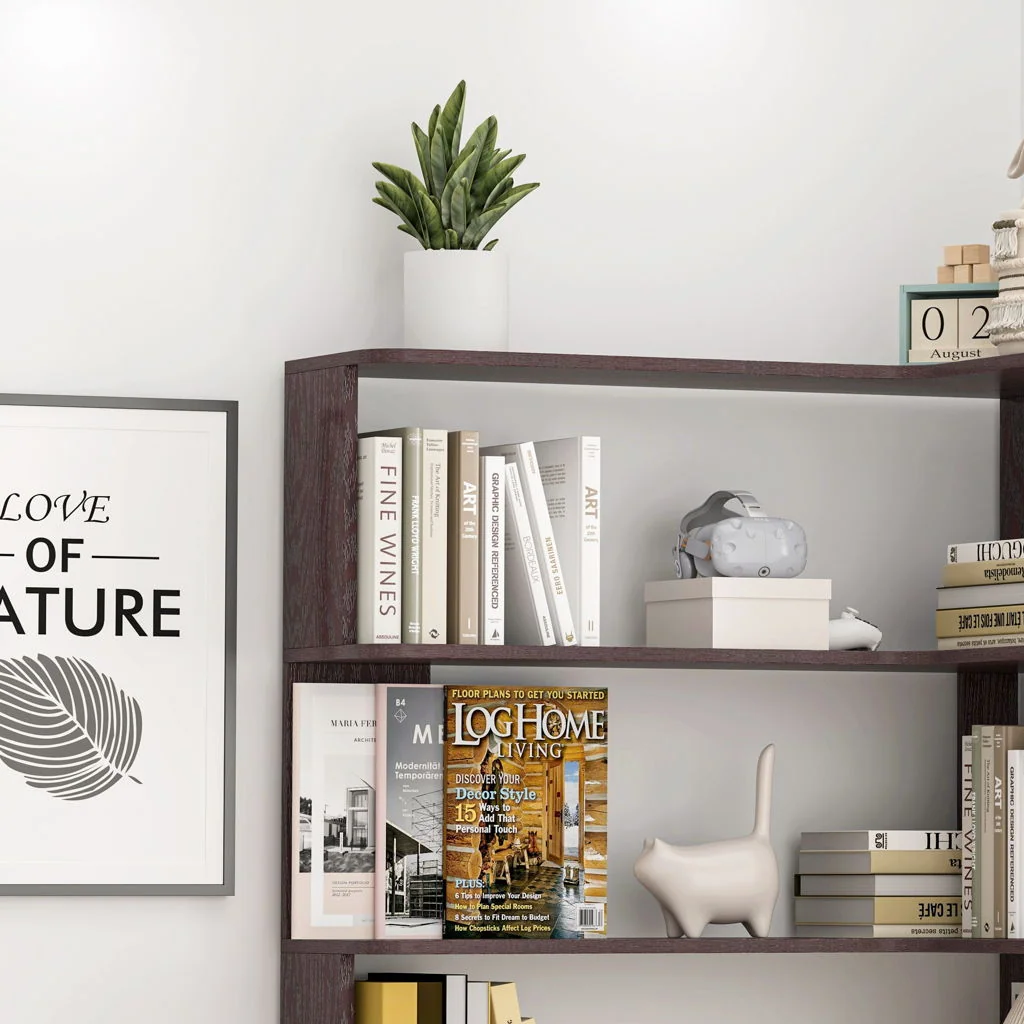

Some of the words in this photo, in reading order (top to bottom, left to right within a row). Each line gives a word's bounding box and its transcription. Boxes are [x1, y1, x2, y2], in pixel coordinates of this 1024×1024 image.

[930, 348, 982, 361] August
[380, 466, 396, 521] FINE
[463, 481, 477, 516] ART
[491, 472, 500, 512] GRAPHIC
[584, 486, 598, 519] ART
[0, 490, 110, 523] LOVE
[491, 515, 500, 548] DESIGN
[26, 537, 84, 573] OF
[411, 546, 420, 574] WRIGHT
[380, 533, 396, 616] WINES
[491, 550, 499, 610] REFERENCED
[0, 585, 180, 638] ATURE
[452, 689, 480, 698] FLOOR
[482, 690, 510, 699] PLANS
[514, 690, 524, 699] TO
[528, 690, 544, 700] GET
[547, 690, 564, 700] YOU
[567, 691, 605, 700] STARTED
[498, 742, 562, 758] LIVING
[455, 774, 496, 784] DISCOVER
[498, 773, 520, 784] YOUR
[964, 764, 972, 817] FINE
[456, 787, 496, 800] Decor
[500, 787, 536, 804] Style
[479, 803, 500, 813] Ways
[503, 804, 510, 812] to
[455, 803, 477, 822] 15
[479, 814, 495, 822] Add
[498, 814, 516, 822] That
[455, 824, 491, 834] Personal
[494, 825, 518, 834] Touch
[455, 879, 485, 888] PLUS:
[964, 830, 972, 910] WINES
[491, 903, 511, 911] Special
[529, 914, 550, 922] Budget
